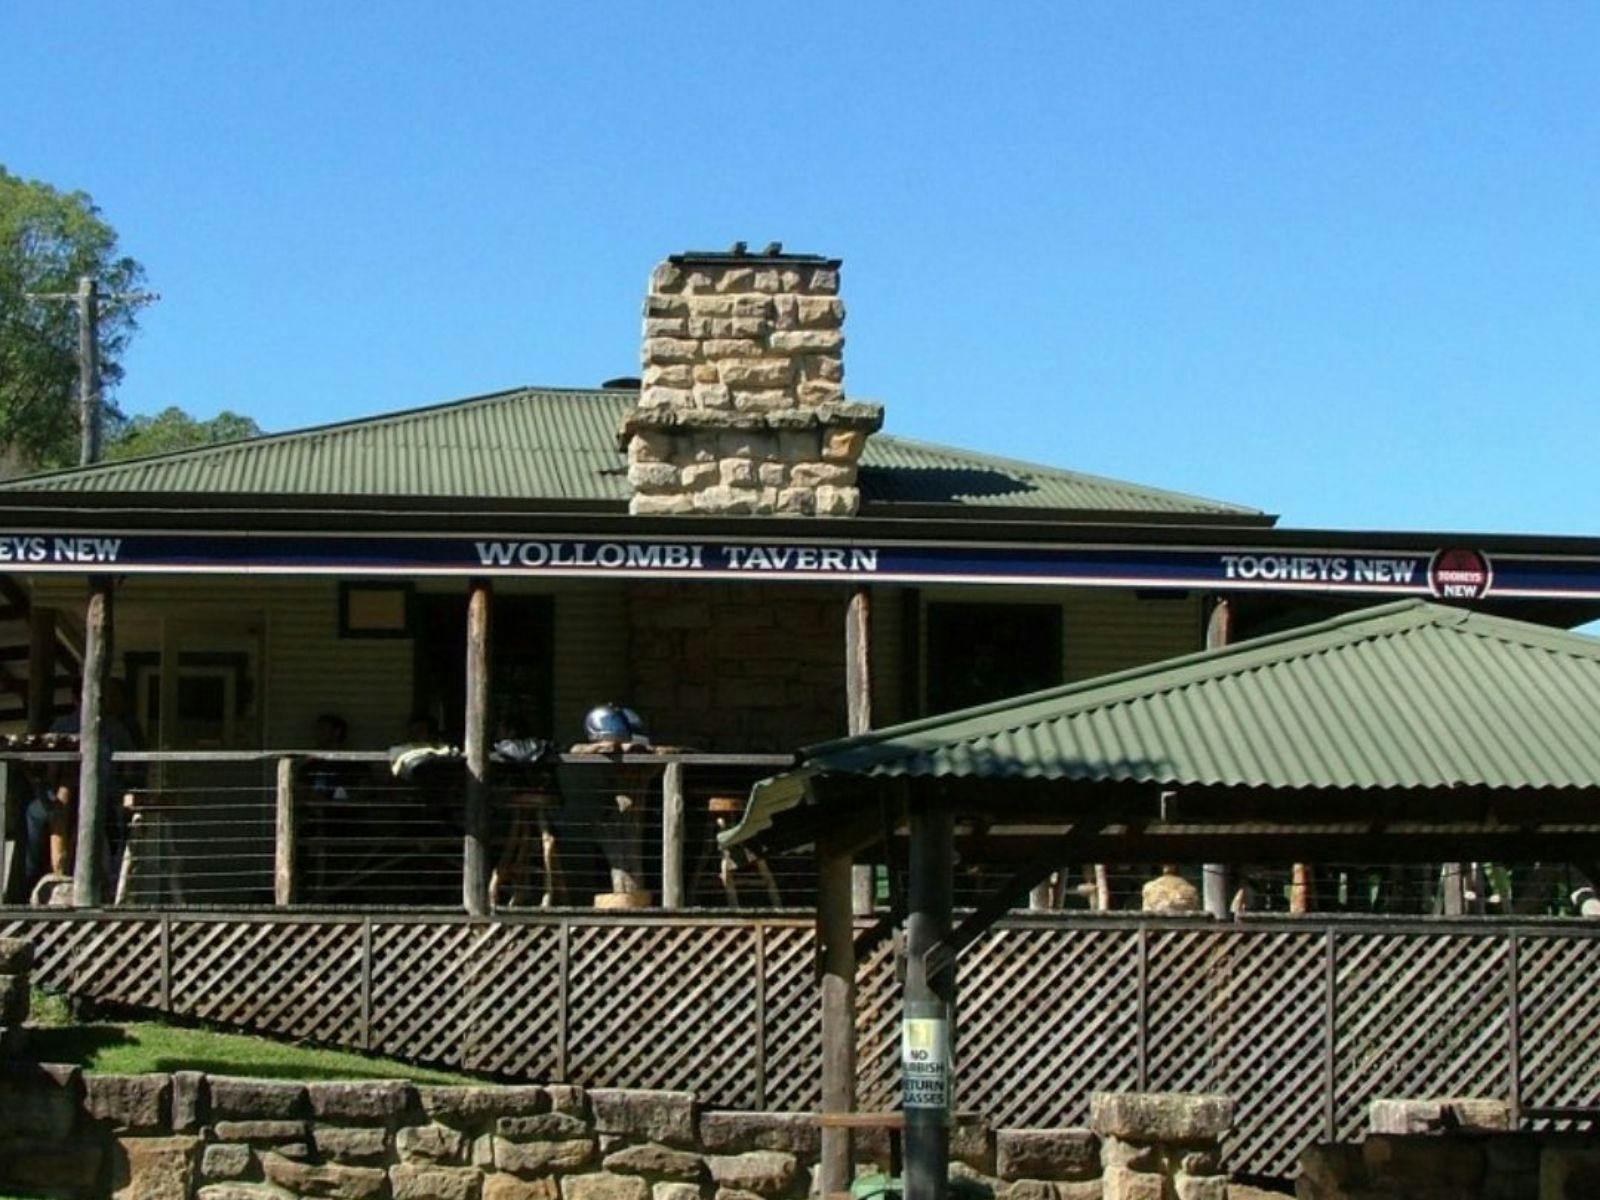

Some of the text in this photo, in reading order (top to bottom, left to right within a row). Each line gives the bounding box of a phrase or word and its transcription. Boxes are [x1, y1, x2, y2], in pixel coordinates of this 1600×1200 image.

[54, 538, 121, 561] NEW
[474, 541, 878, 572] WOLLOMBI TAVERN
[1221, 555, 1416, 583] TOOHEYS NEW
[1438, 570, 1483, 582] TOOHEYS
[1444, 584, 1477, 597] NEW
[910, 1049, 929, 1060] NO
